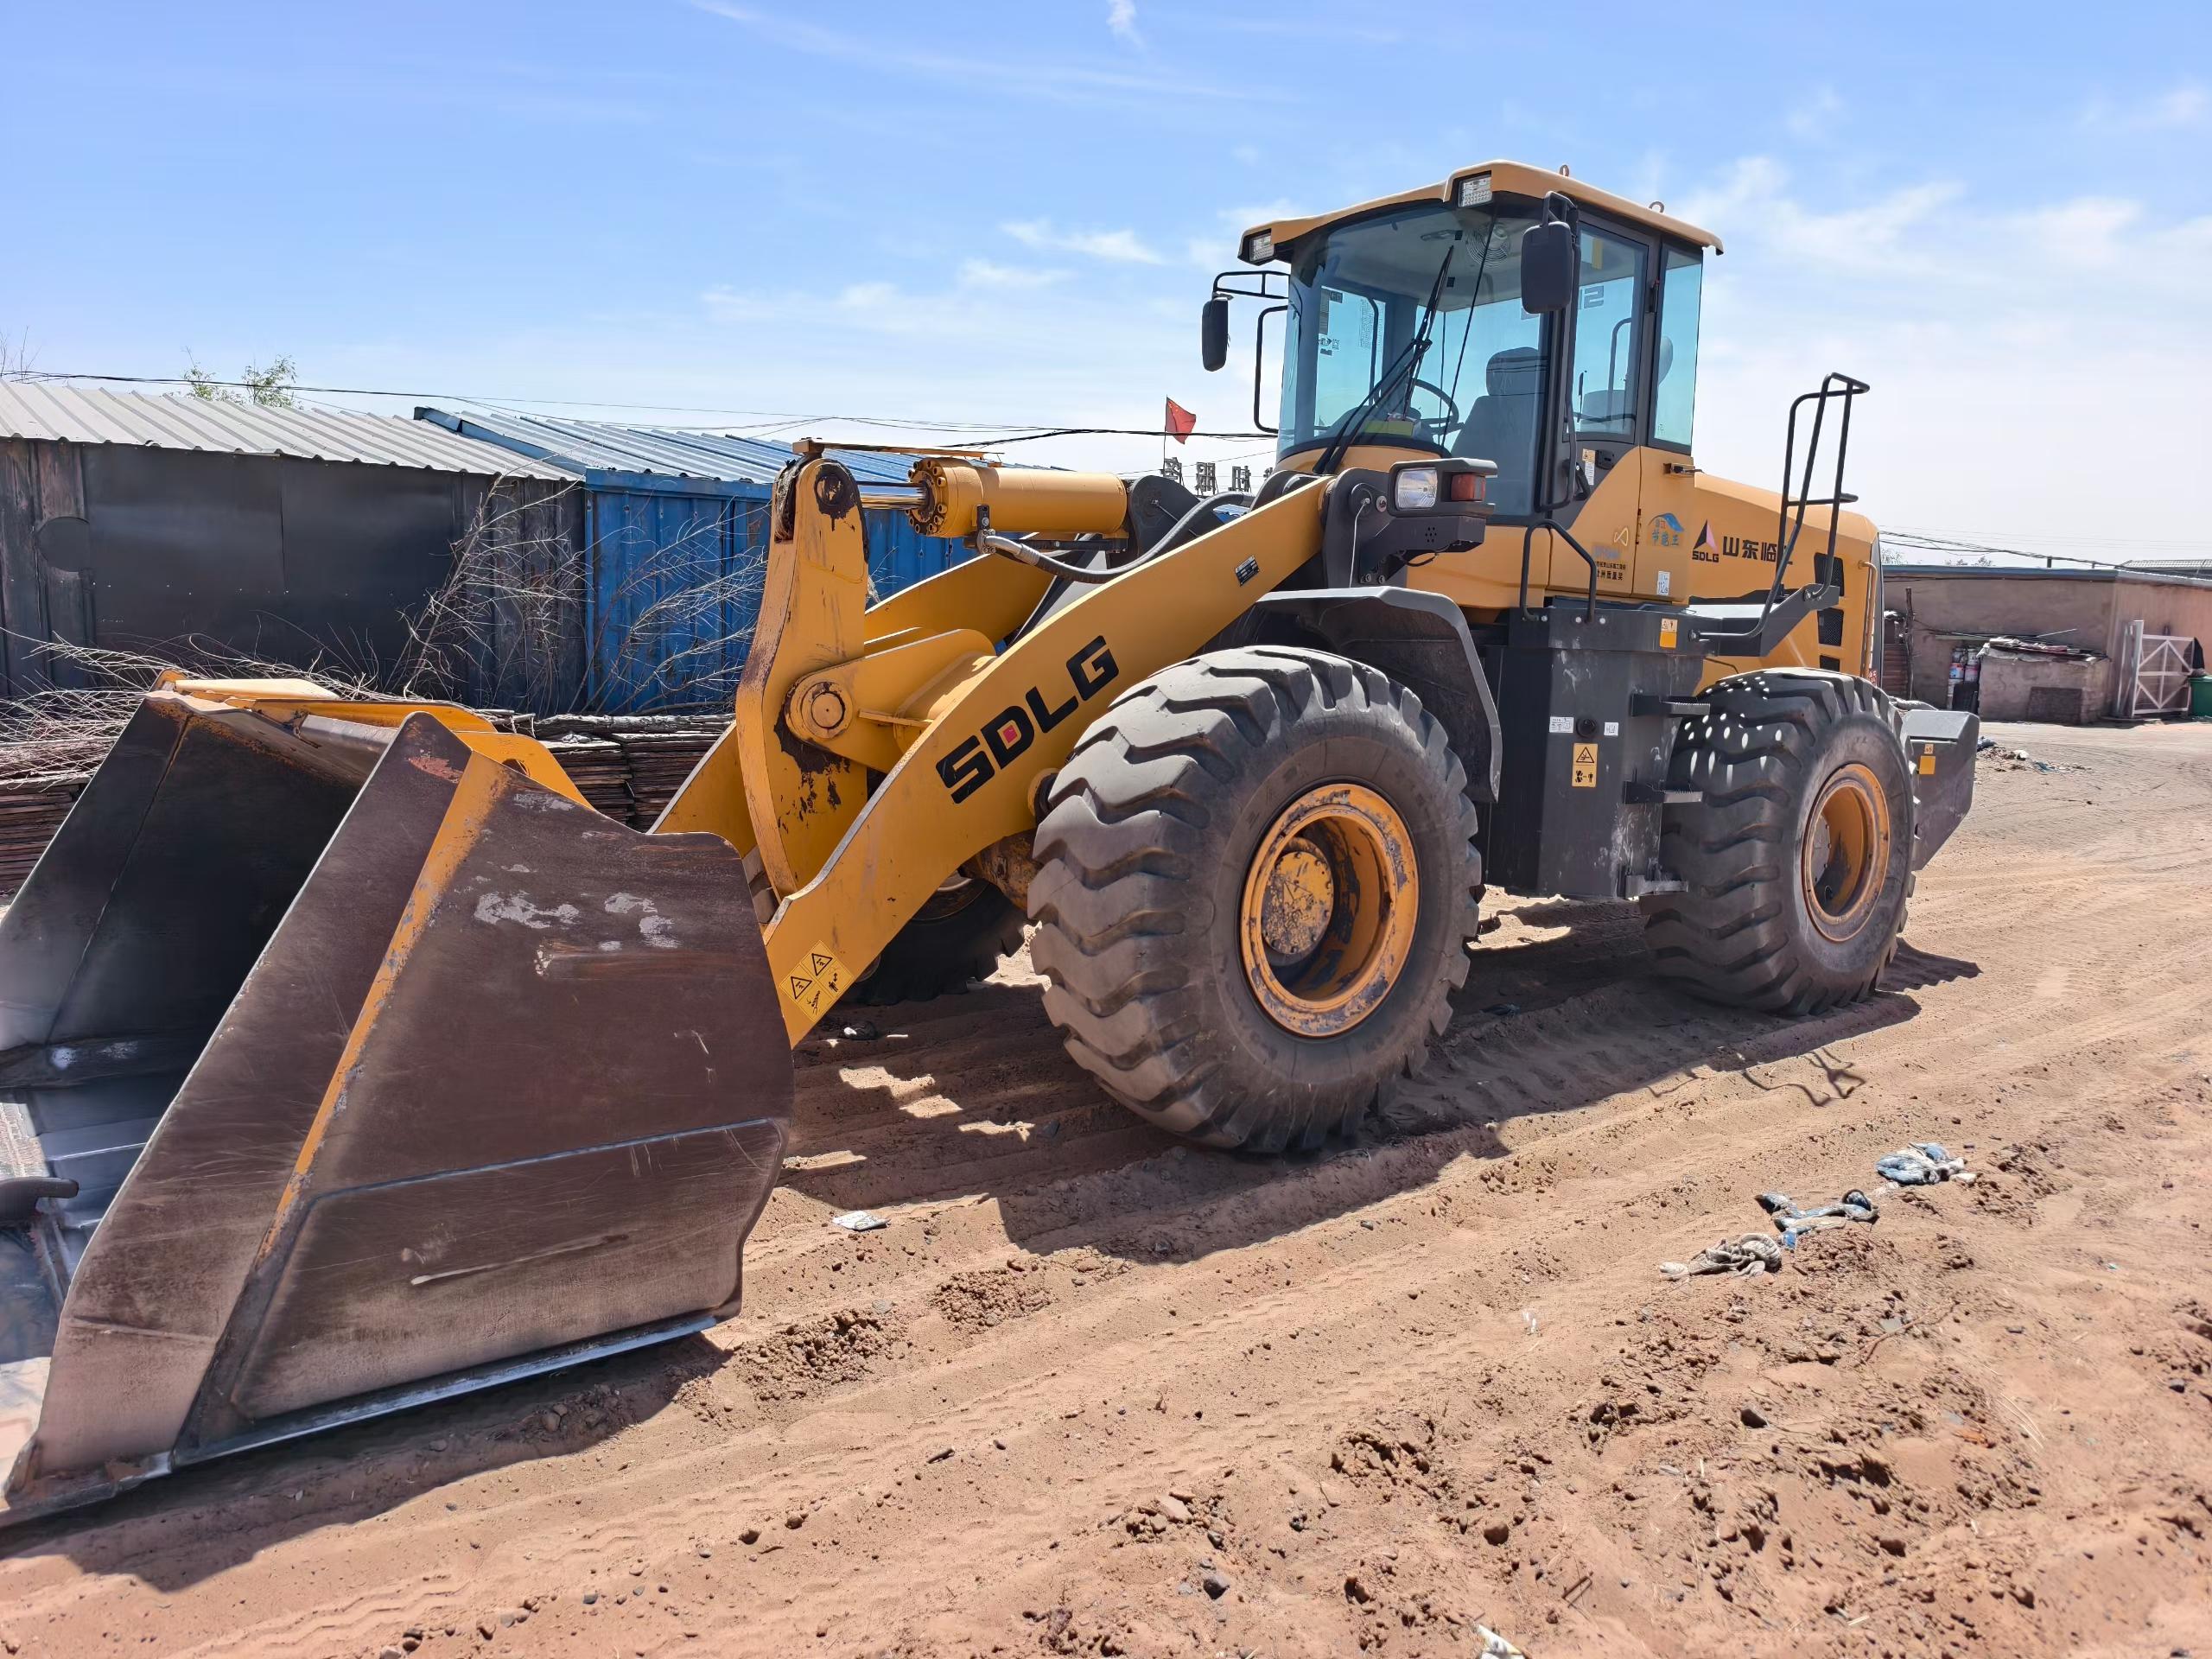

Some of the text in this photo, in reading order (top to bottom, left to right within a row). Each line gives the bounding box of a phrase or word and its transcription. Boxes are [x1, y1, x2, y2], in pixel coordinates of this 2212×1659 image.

[1691, 550, 1719, 563] SDLG
[1722, 536, 1793, 565] 山东临
[936, 635, 1120, 804] SDLG
